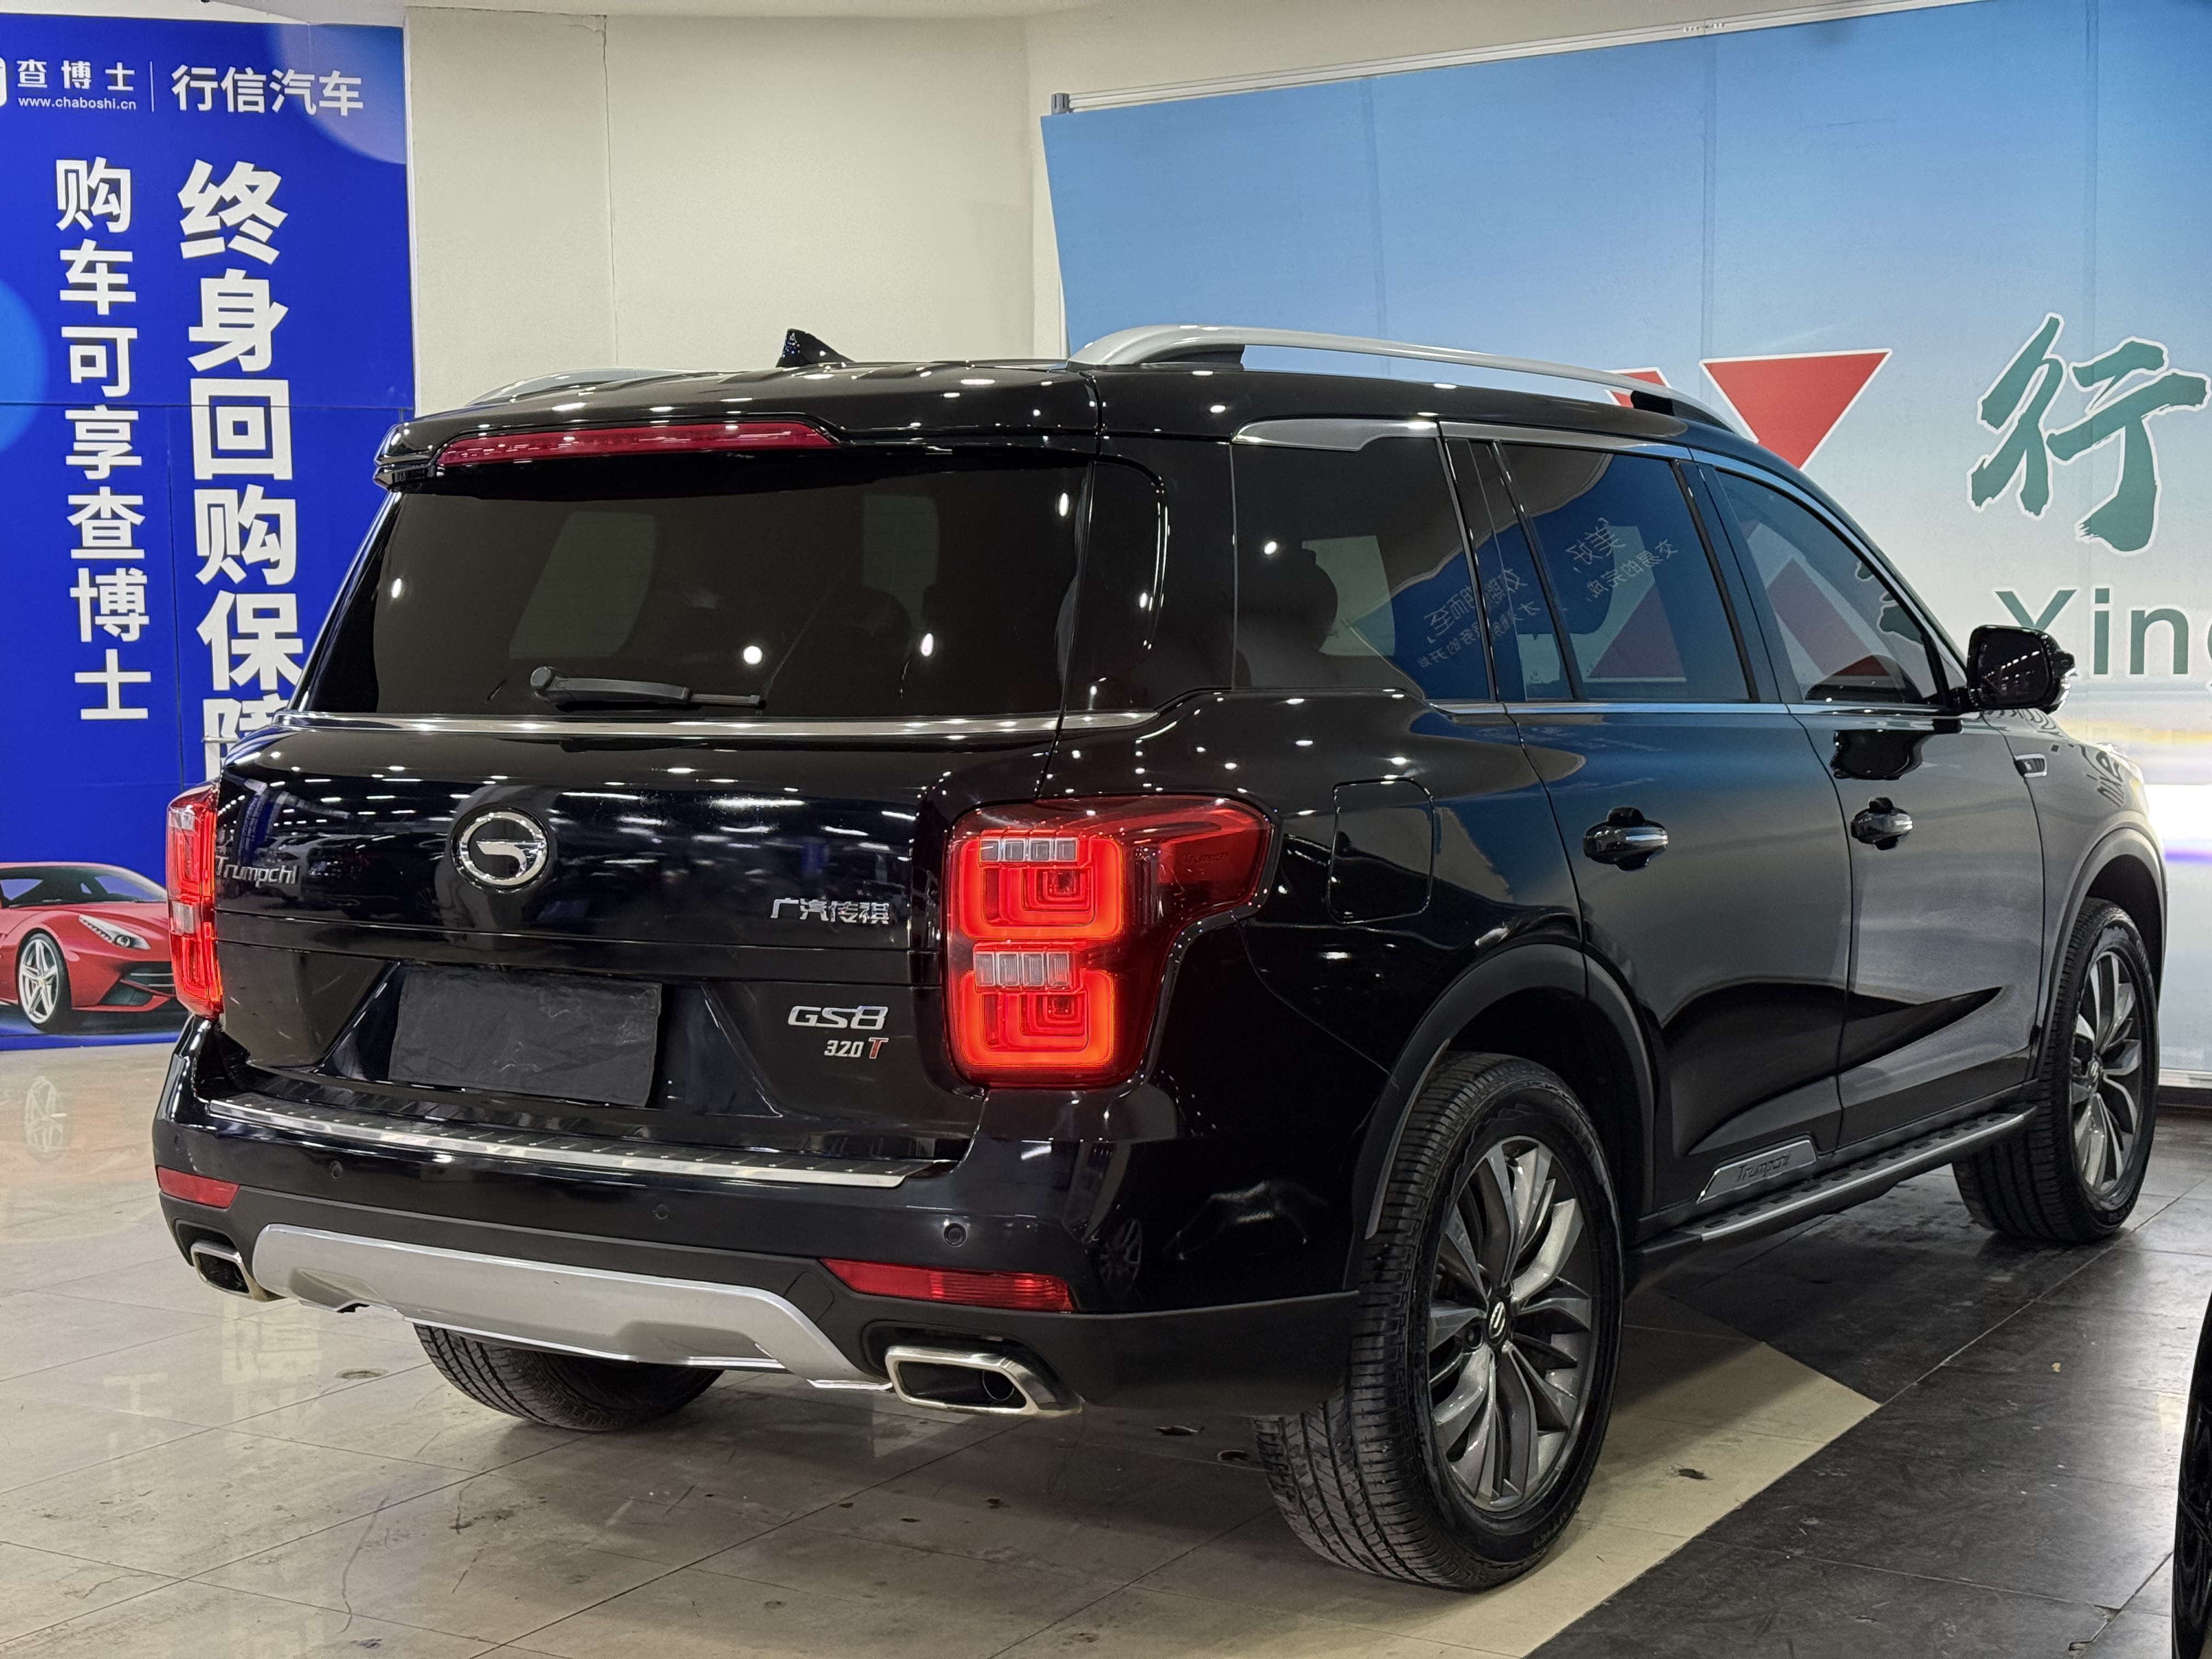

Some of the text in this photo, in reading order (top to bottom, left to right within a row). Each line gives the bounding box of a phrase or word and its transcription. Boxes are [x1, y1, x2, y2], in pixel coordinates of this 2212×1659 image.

[17, 59, 135, 91] 查博士
[171, 65, 363, 116] 行信汽车
[18, 96, 137, 110] www.chaboshi.cn
[55, 157, 151, 720] 购车可享查博士
[1968, 313, 2209, 554] 行
[770, 897, 890, 924] 广汽传祺
[787, 1005, 889, 1030] GS8
